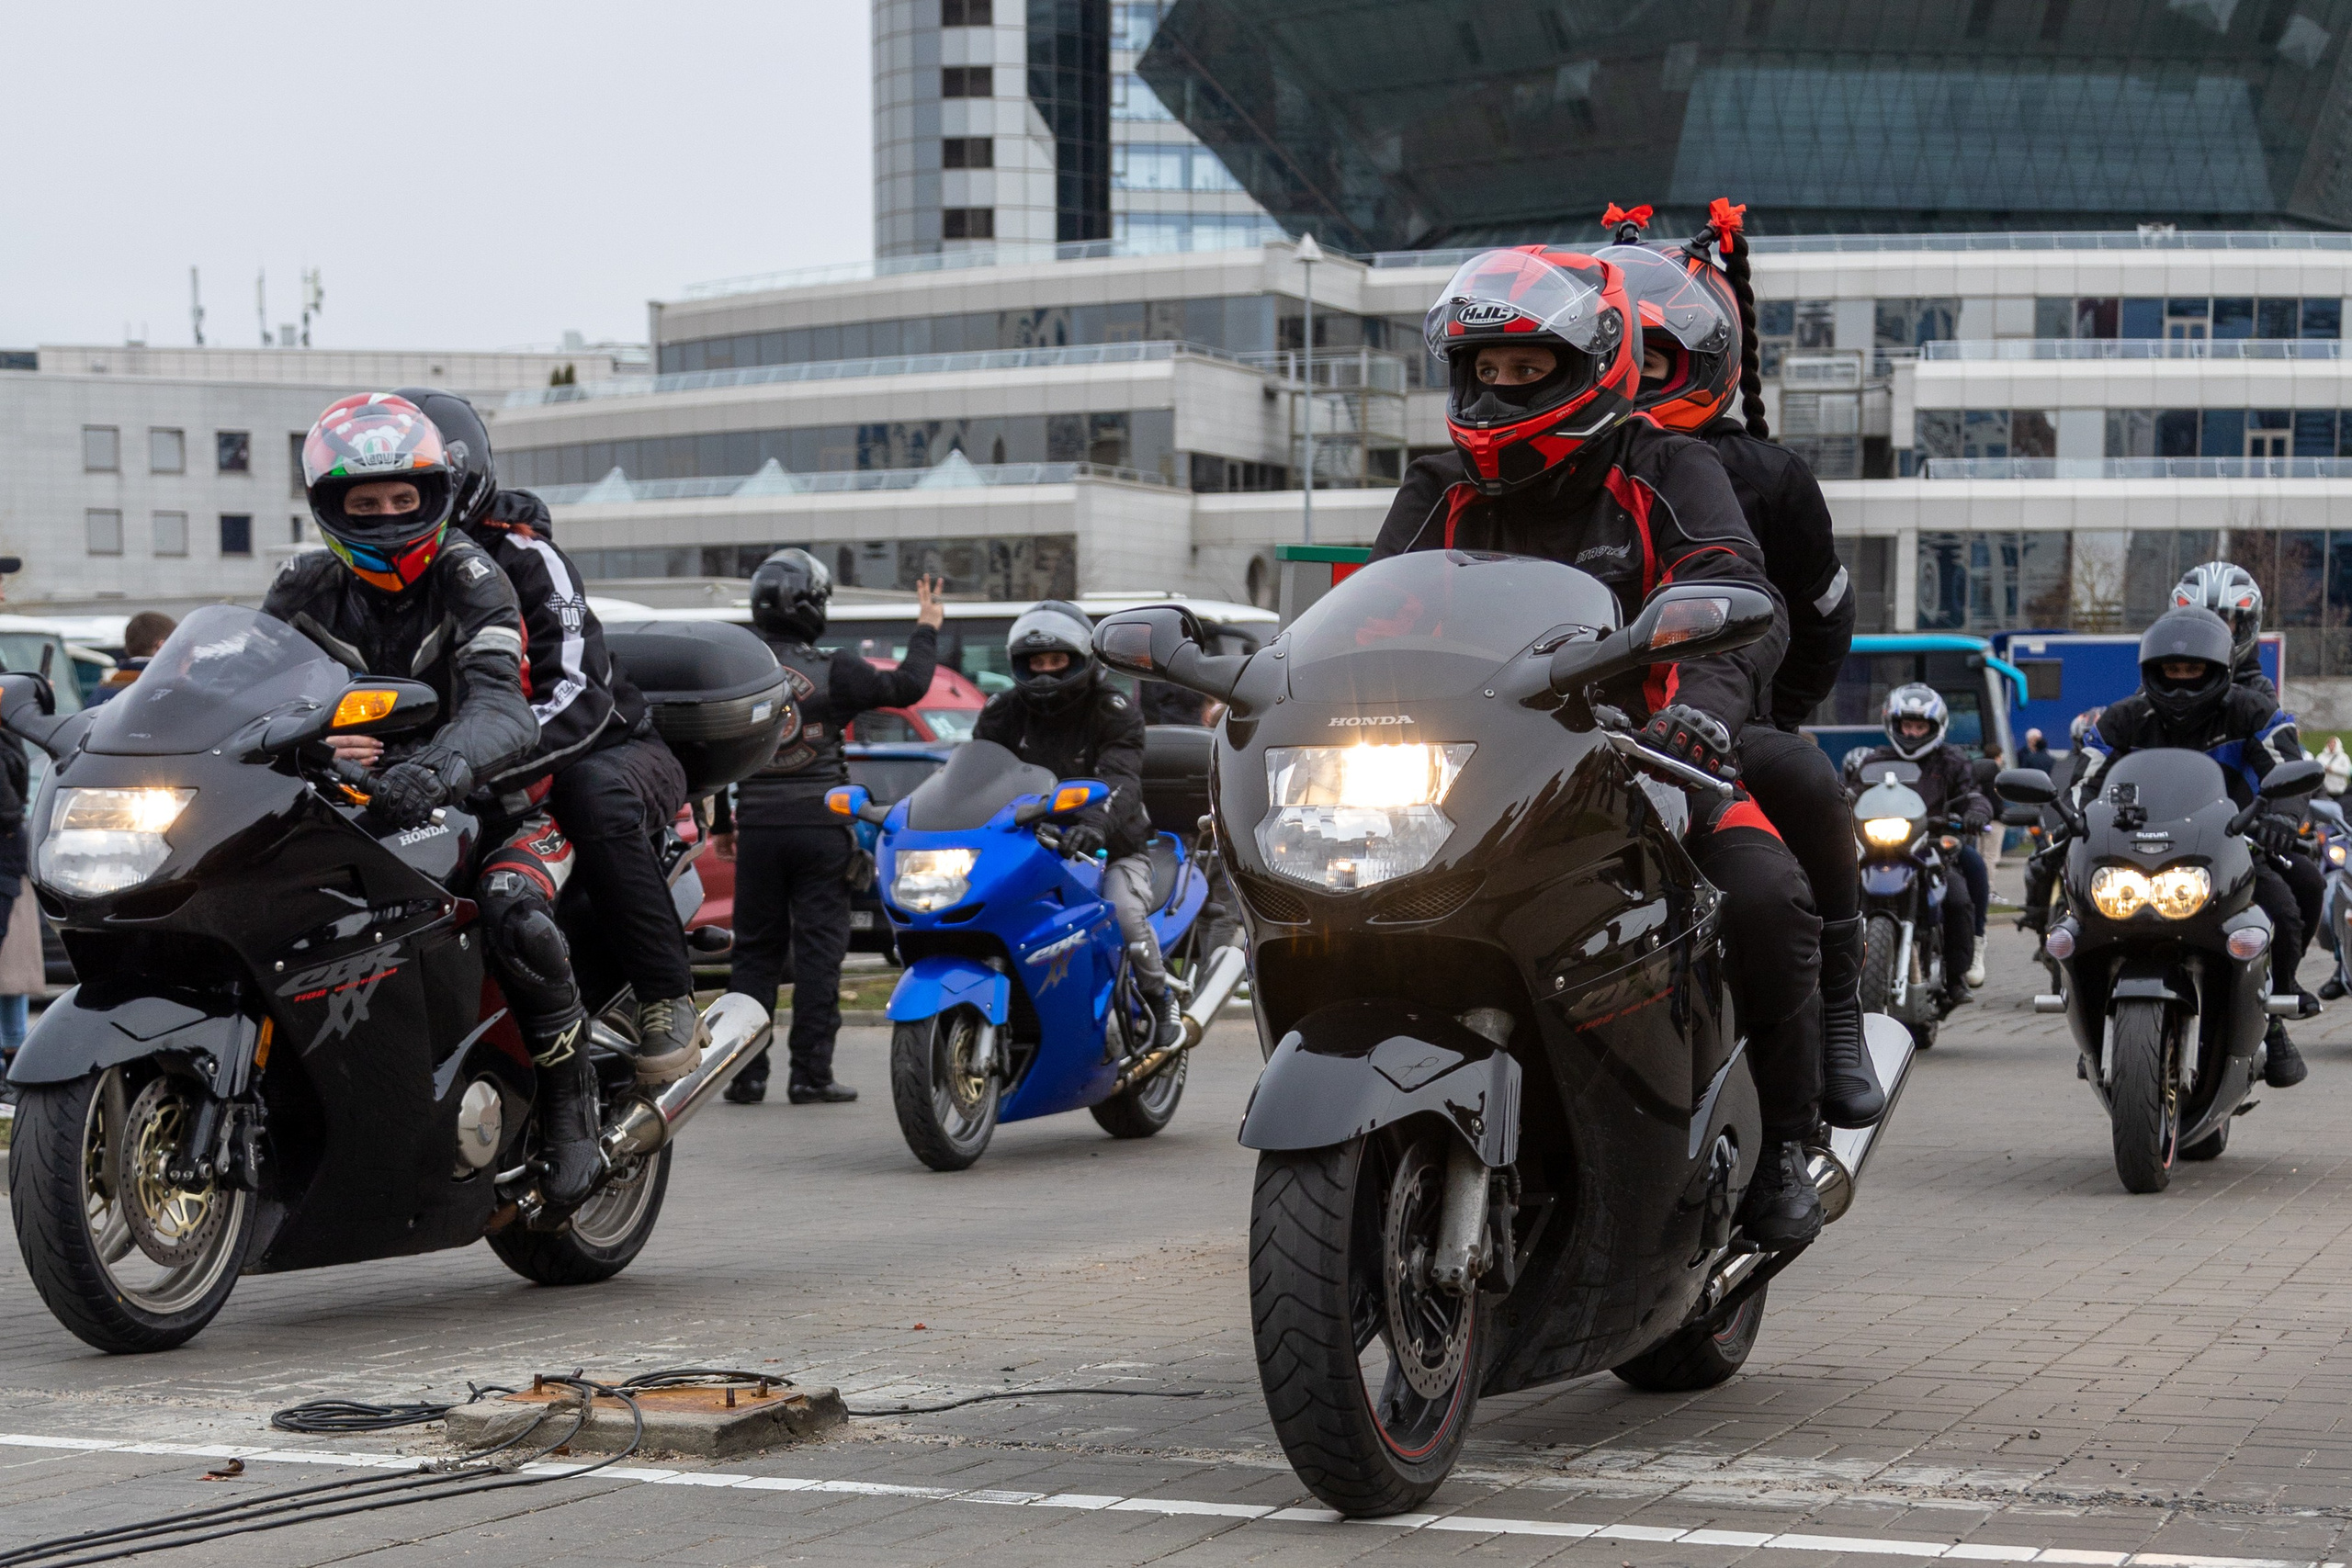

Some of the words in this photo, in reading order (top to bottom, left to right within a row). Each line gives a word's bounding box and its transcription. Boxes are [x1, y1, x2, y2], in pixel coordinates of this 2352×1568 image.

[1462, 306, 1510, 321] HJC
[1328, 716, 1415, 727] HONDA
[399, 825, 450, 847] HONDA
[276, 942, 410, 997] CBR
